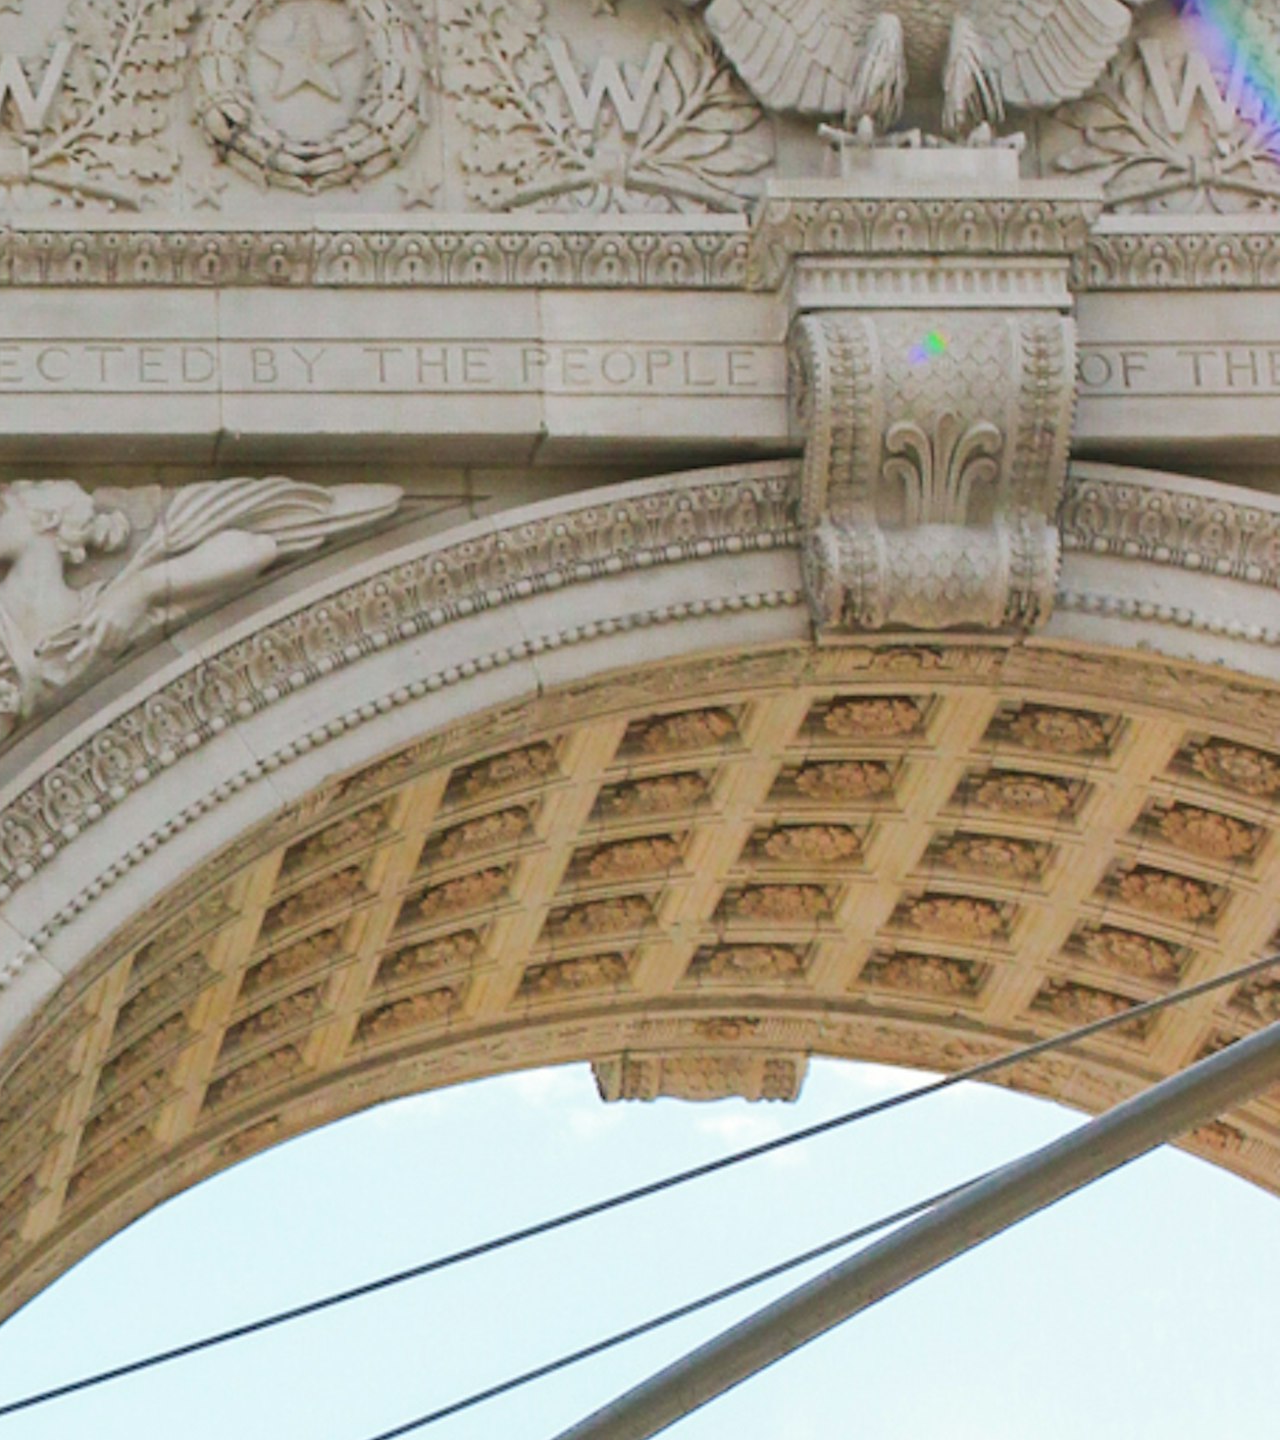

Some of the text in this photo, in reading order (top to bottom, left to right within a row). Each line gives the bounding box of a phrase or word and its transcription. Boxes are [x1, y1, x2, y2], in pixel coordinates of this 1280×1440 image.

[542, 35, 670, 132] W
[252, 348, 327, 384] BY
[363, 347, 494, 385] THE
[520, 349, 759, 387] PEOPLE
[1078, 352, 1149, 388] OF
